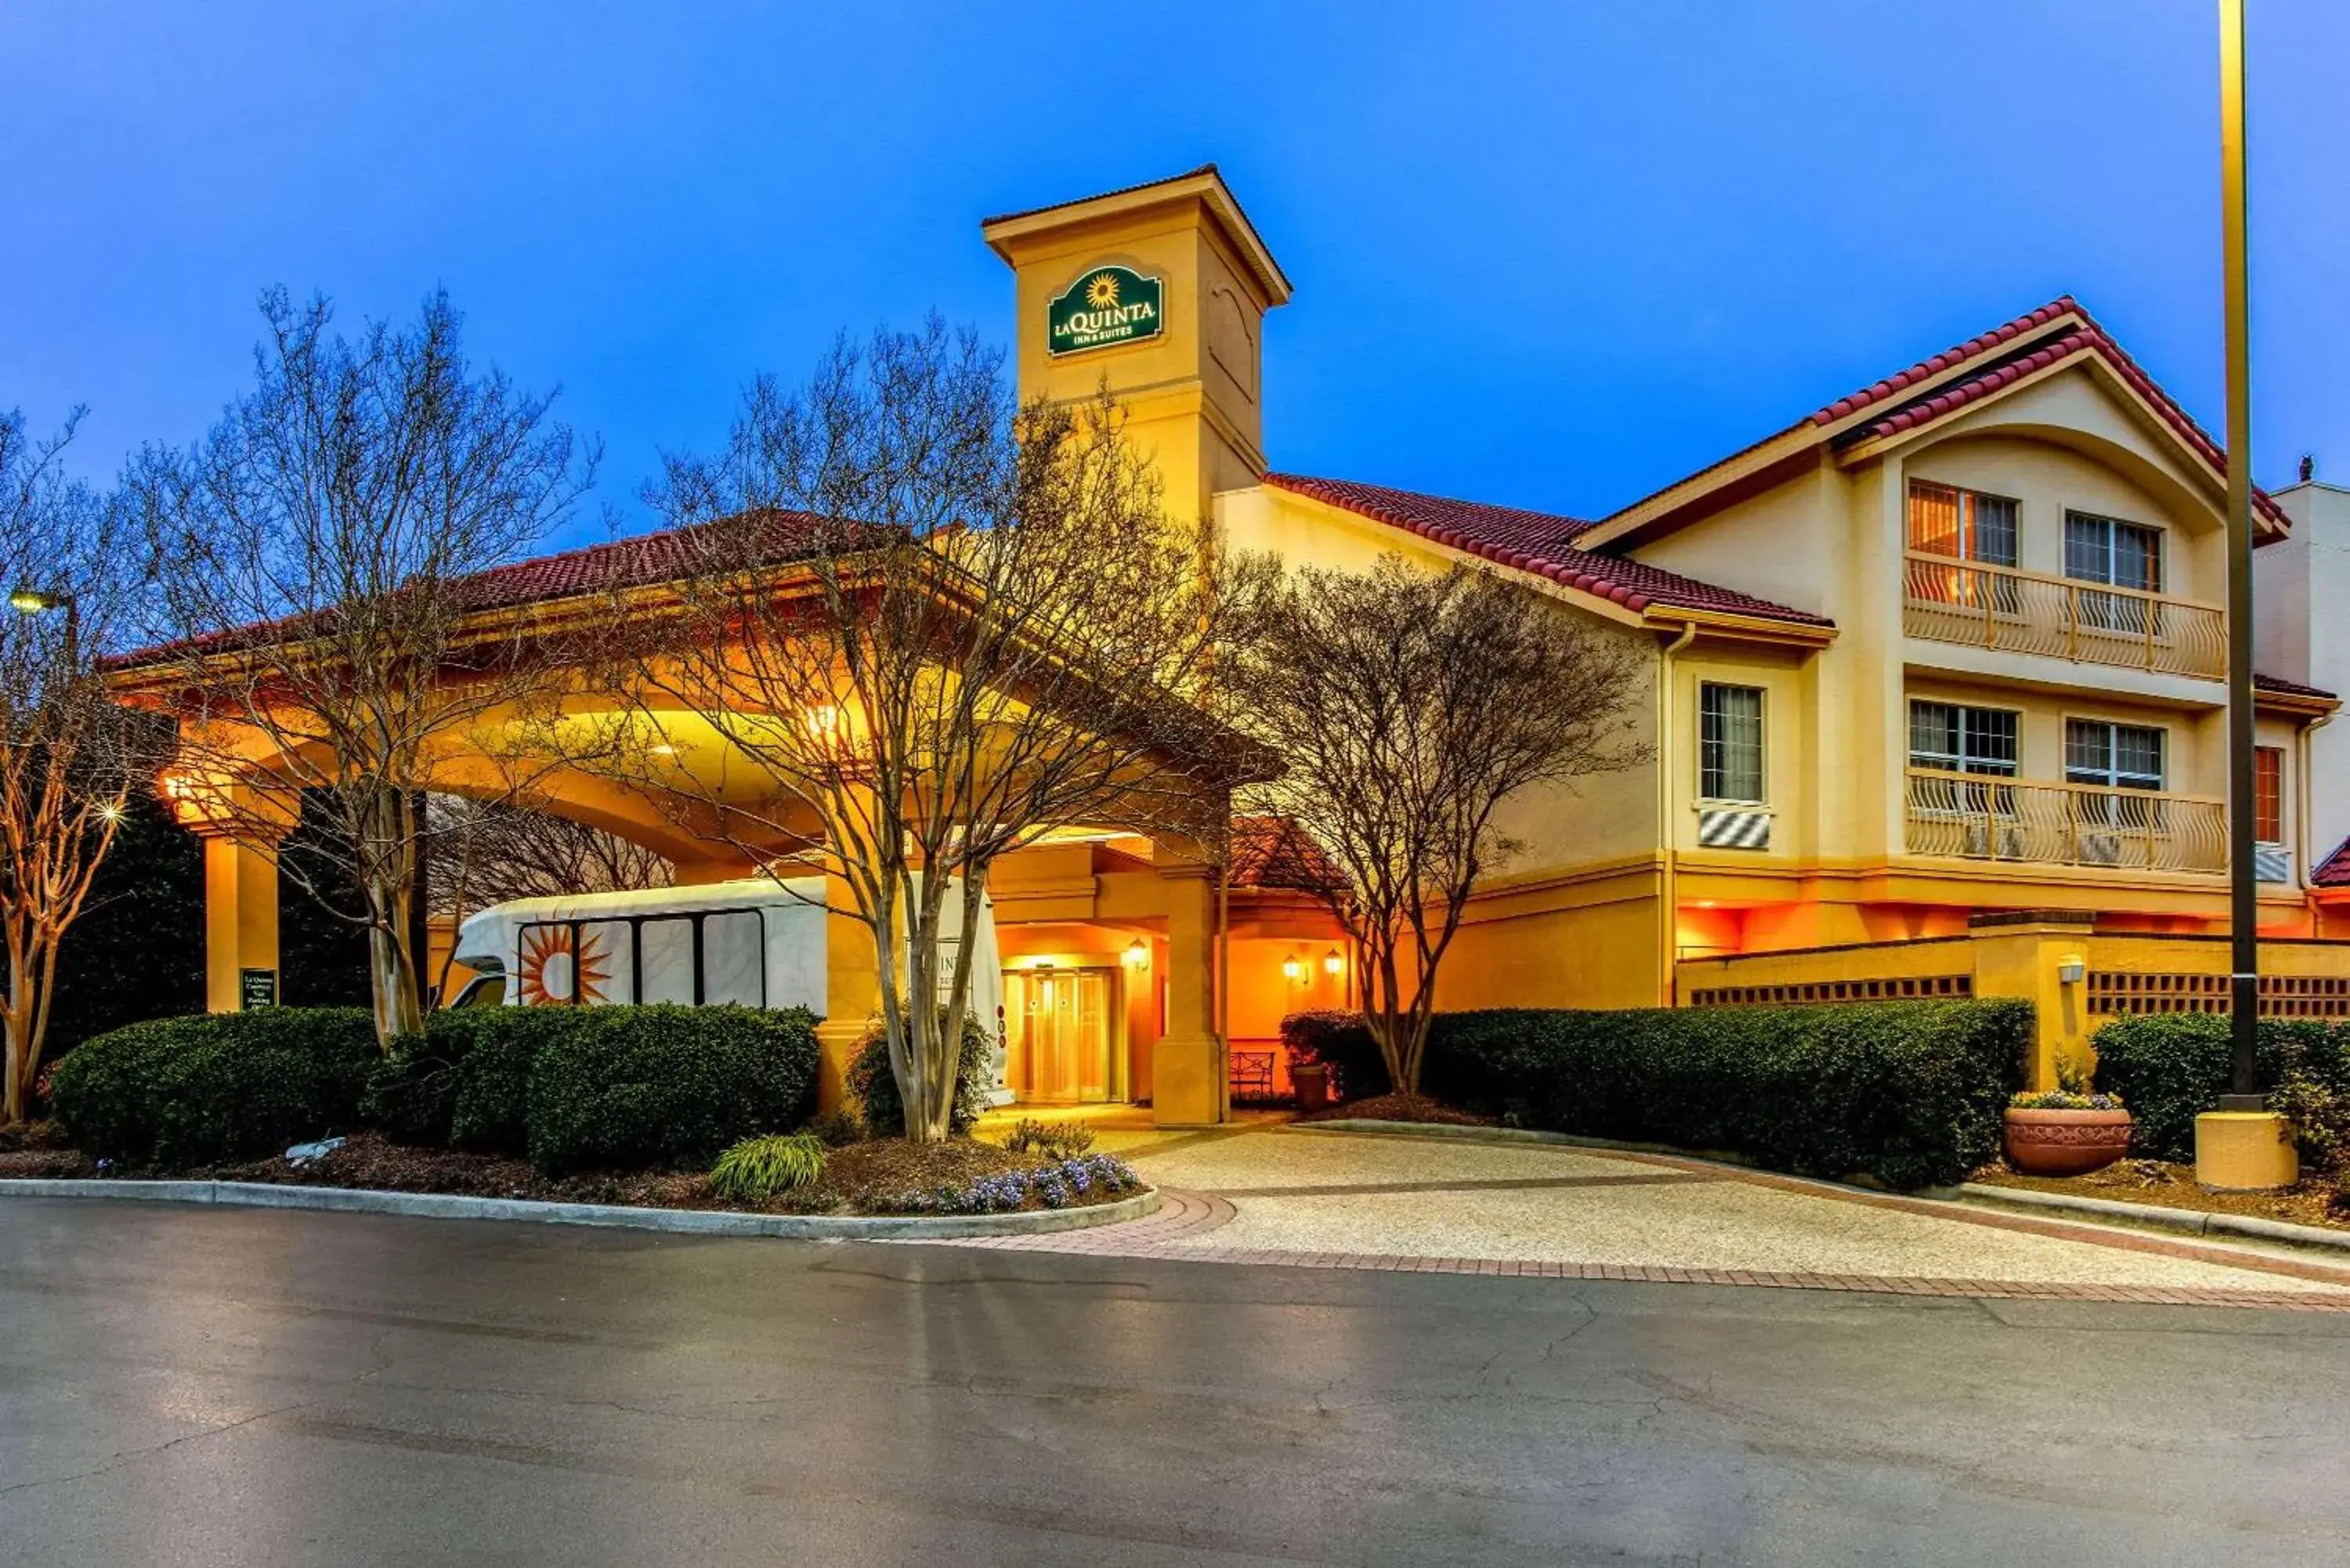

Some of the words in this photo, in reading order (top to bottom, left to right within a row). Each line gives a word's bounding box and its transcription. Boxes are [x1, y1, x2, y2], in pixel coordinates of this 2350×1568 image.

[1055, 324, 1070, 337] LA
[1070, 302, 1153, 334] QUINTA
[1074, 335, 1090, 345] INN
[1099, 326, 1133, 341] SUITES
